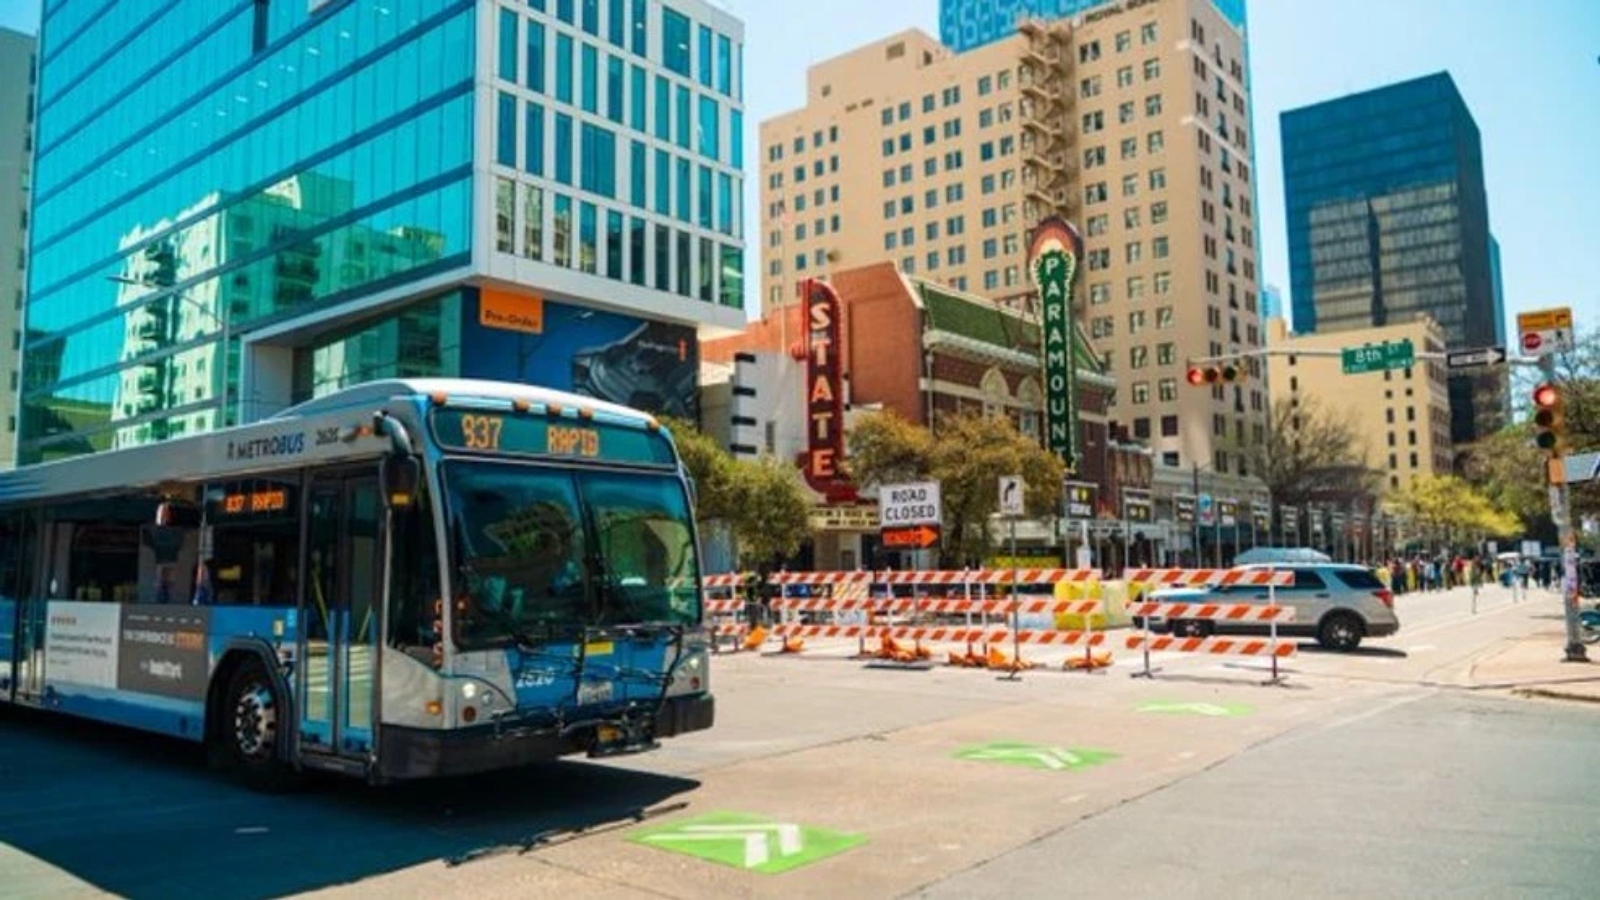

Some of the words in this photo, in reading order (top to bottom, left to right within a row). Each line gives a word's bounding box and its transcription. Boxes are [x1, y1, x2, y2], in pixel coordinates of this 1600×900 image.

[1355, 349, 1382, 363] 8th
[810, 303, 835, 477] STATE
[237, 431, 306, 459] METROBUS
[548, 425, 599, 456] RAPID
[891, 489, 927, 502] ROAD
[885, 504, 936, 520] CLOSED
